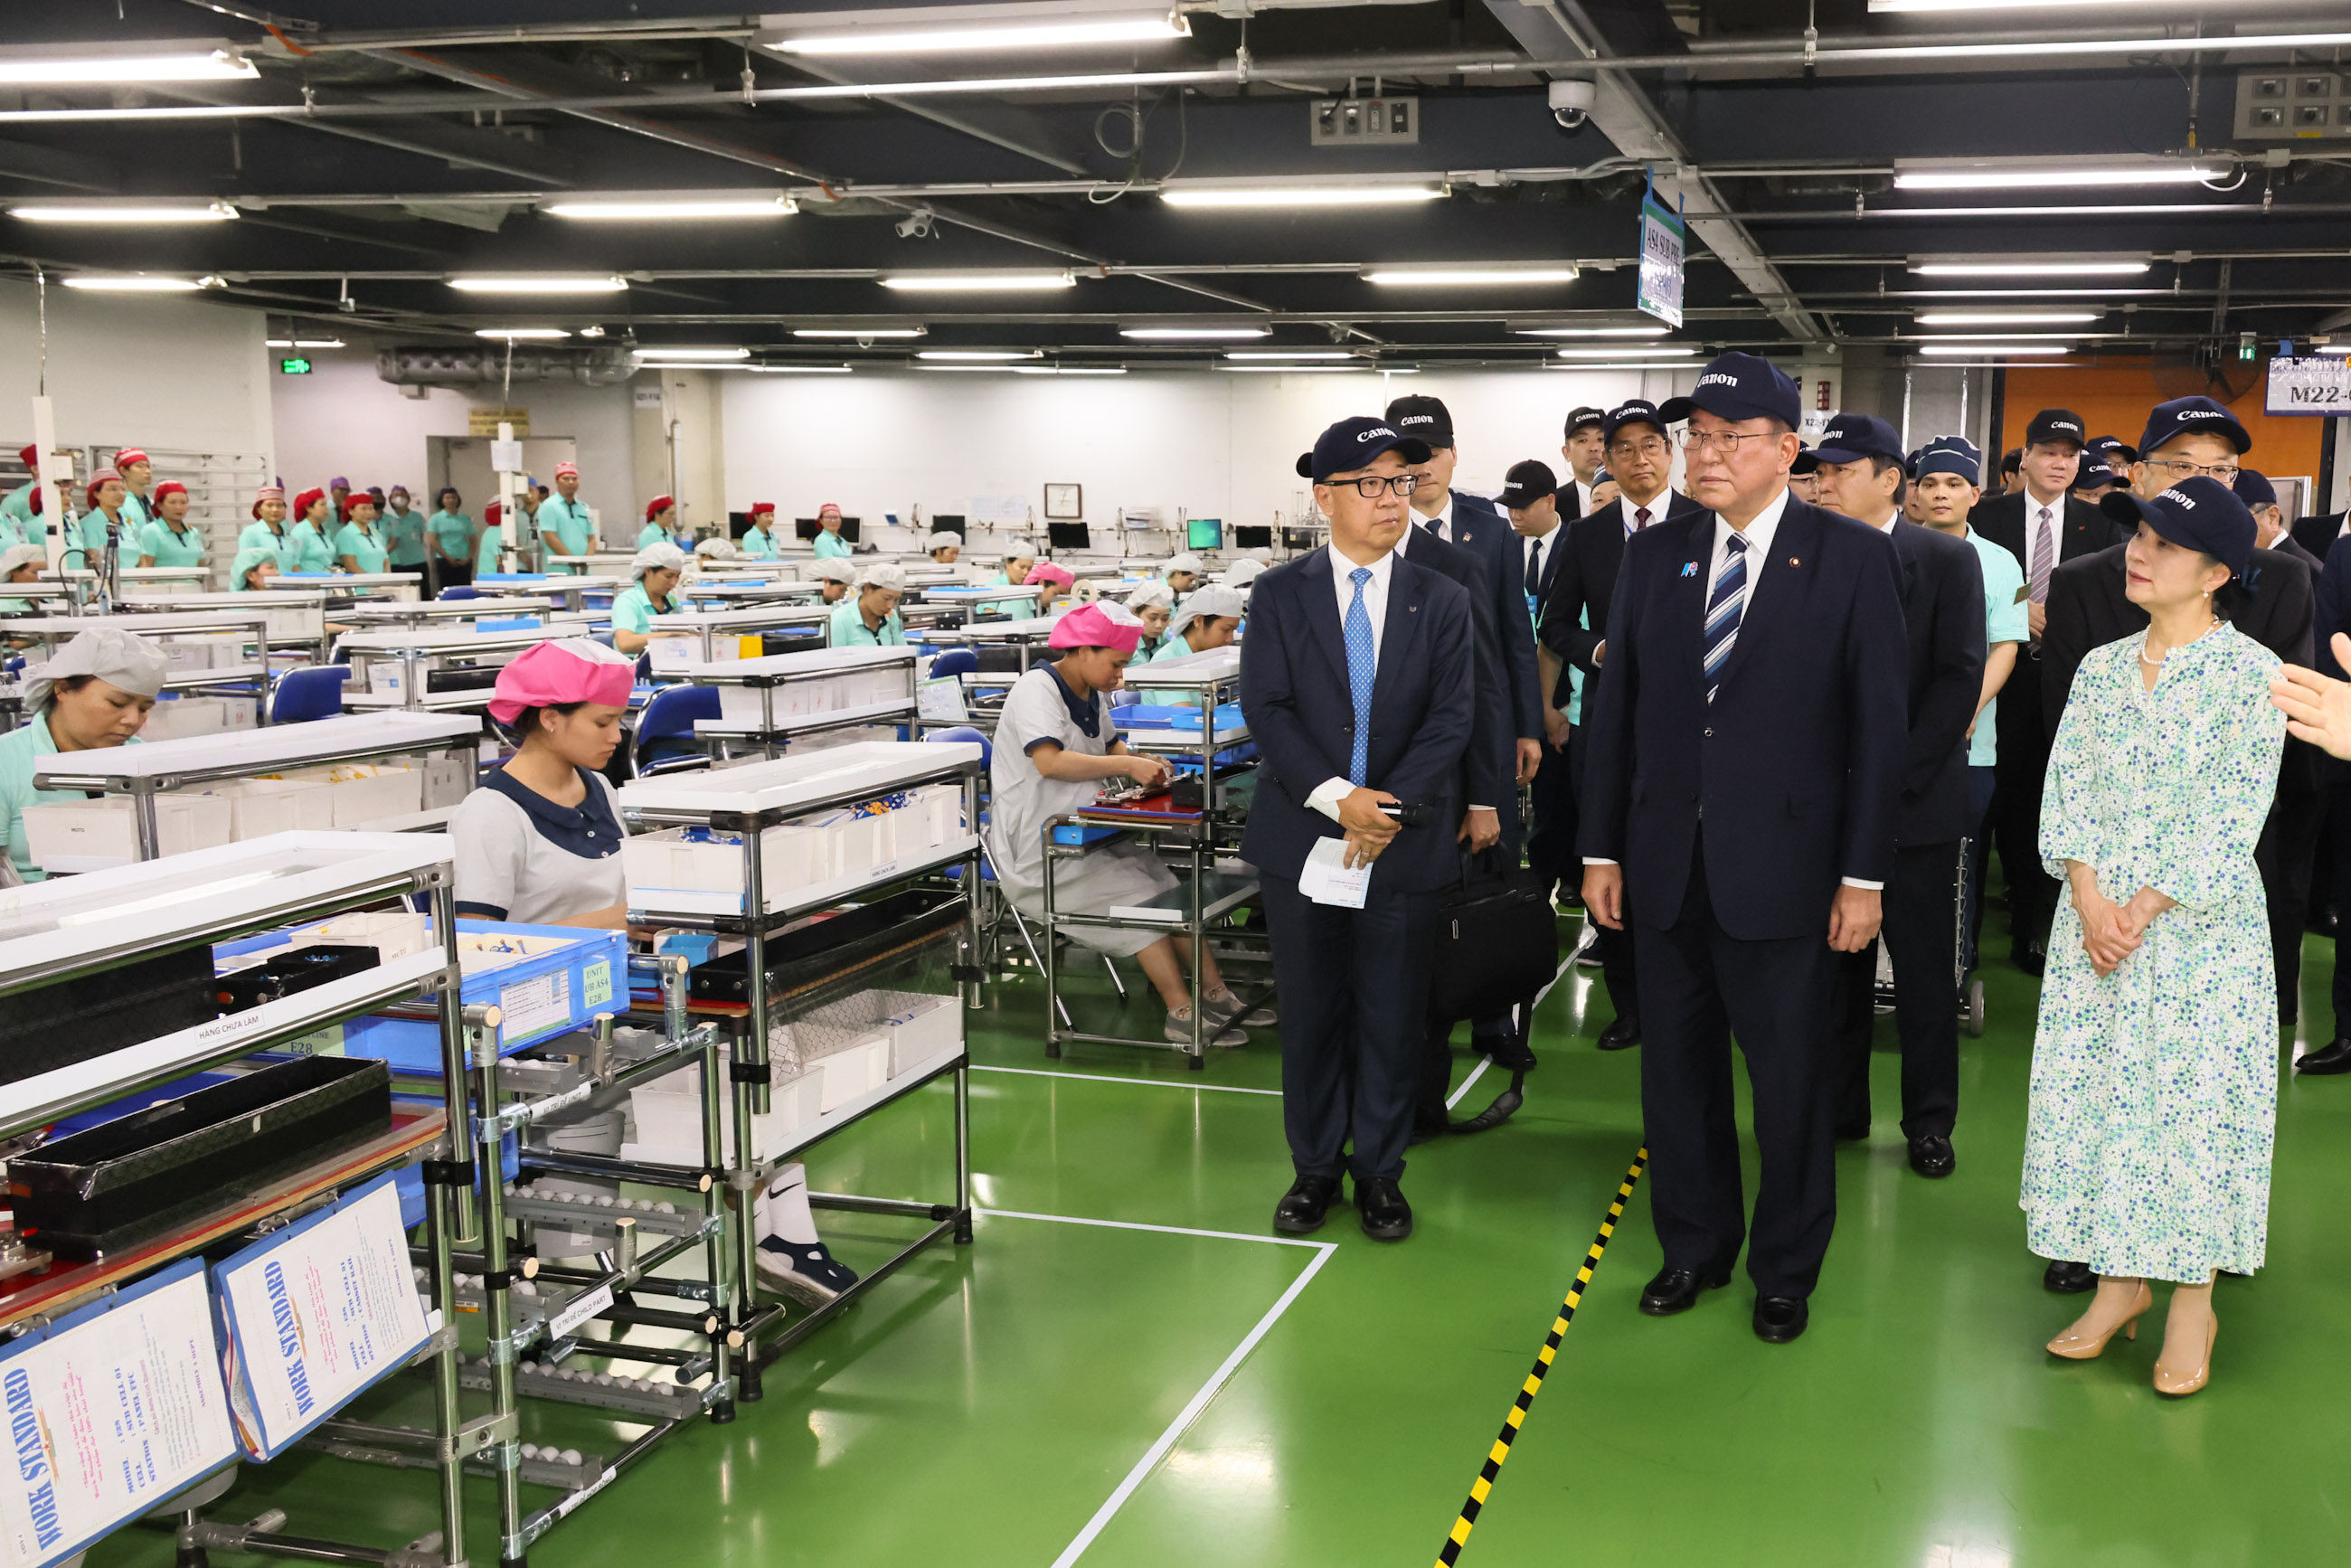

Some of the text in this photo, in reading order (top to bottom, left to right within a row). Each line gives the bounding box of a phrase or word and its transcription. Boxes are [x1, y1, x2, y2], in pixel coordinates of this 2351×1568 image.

[1401, 415, 1434, 426] Canon
[1575, 412, 1600, 422] Canon
[1616, 407, 1648, 420] Canon
[1822, 430, 1844, 440] non
[2051, 421, 2078, 431] Canon
[586, 967, 603, 978] UNIT
[199, 1015, 260, 1039] HÀNG CHƯA LÀM
[290, 1042, 313, 1054] E28
[577, 1304, 592, 1317] CHILD
[593, 1295, 606, 1308] PART
[264, 1261, 316, 1418] WORK STANDARD
[114, 1365, 122, 1380] 01
[117, 1380, 127, 1407] CELL
[123, 1409, 133, 1431] SUB
[131, 1392, 145, 1427] PANEL
[4, 1367, 64, 1552] WORK STANDARD
[142, 1437, 156, 1483] STATION
[121, 1456, 135, 1495] MODEL
[135, 1460, 146, 1488] CELL
